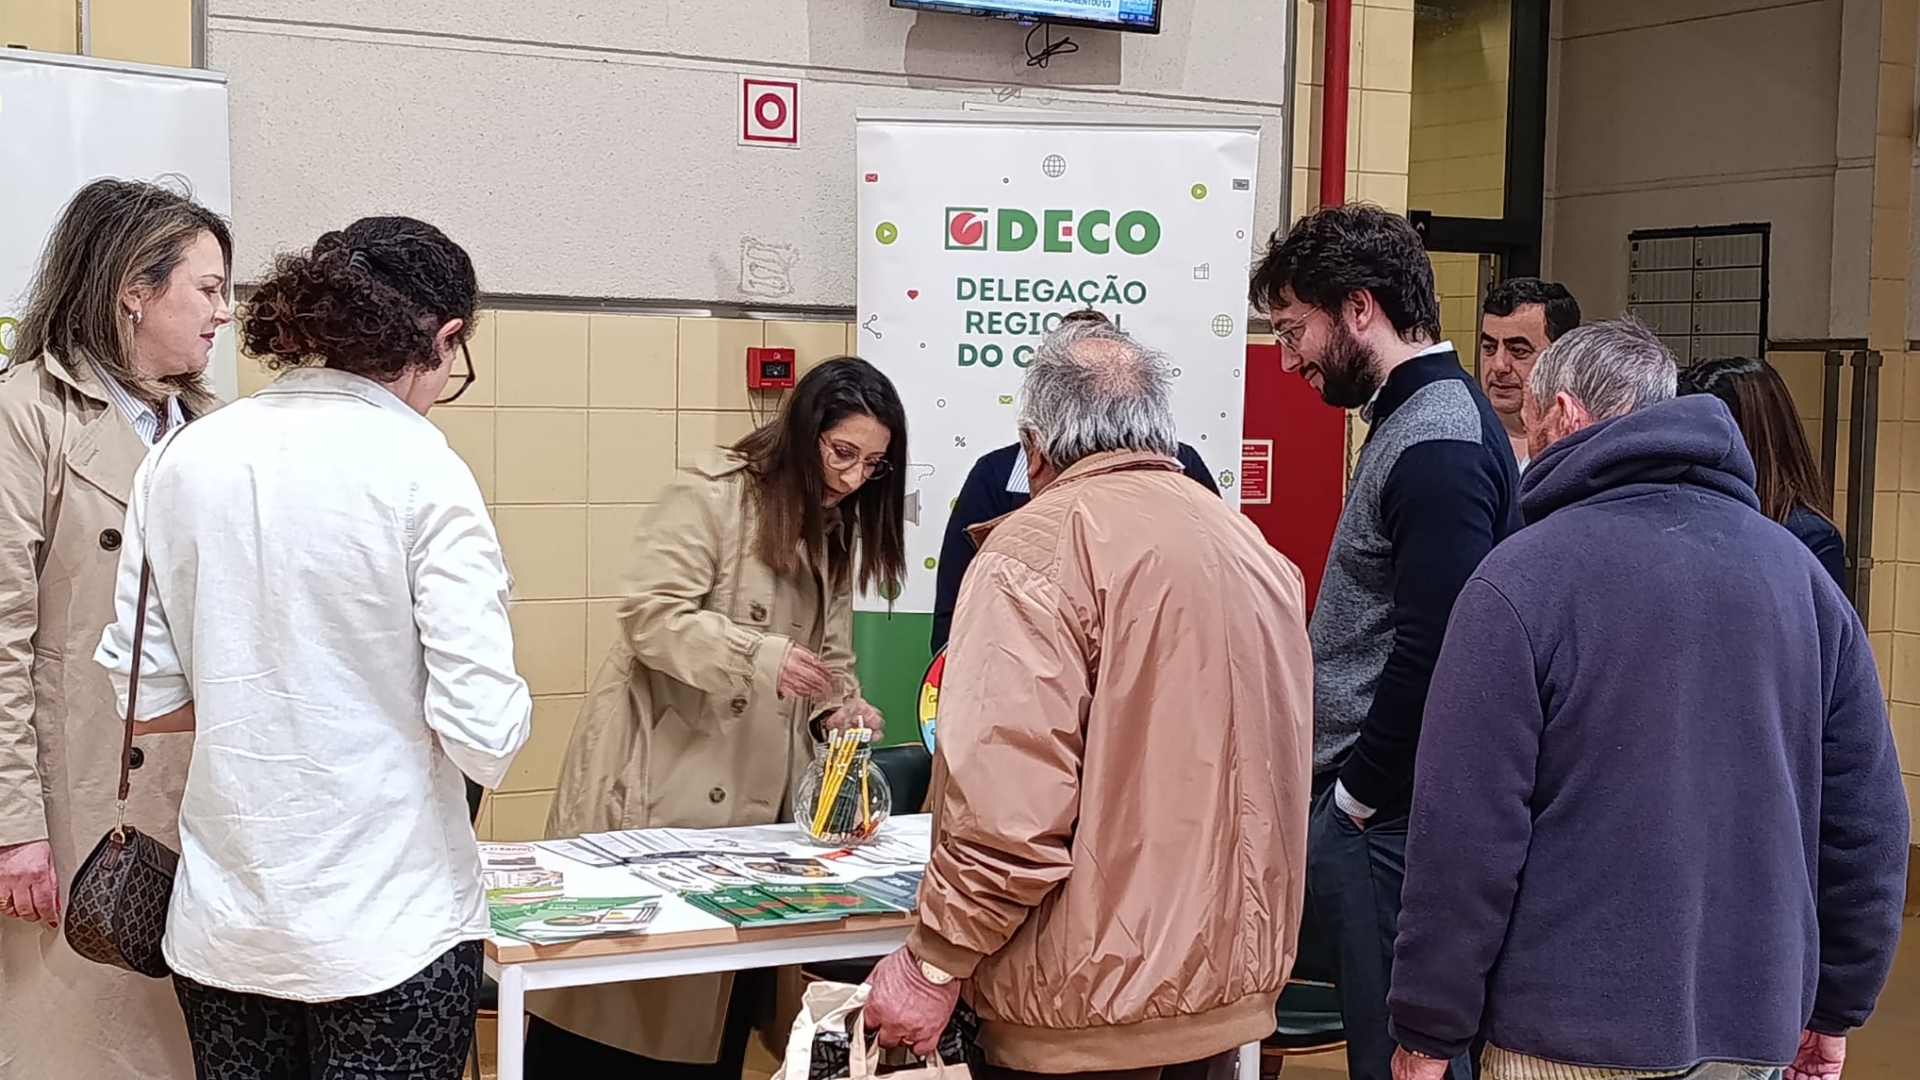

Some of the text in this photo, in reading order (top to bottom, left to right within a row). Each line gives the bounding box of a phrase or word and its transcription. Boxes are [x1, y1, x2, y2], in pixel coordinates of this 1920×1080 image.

[997, 208, 1161, 255] DECO
[956, 275, 1147, 307] DELEGAÇÃO
[966, 310, 1130, 336] REGIOL
[958, 344, 1003, 367] DO
